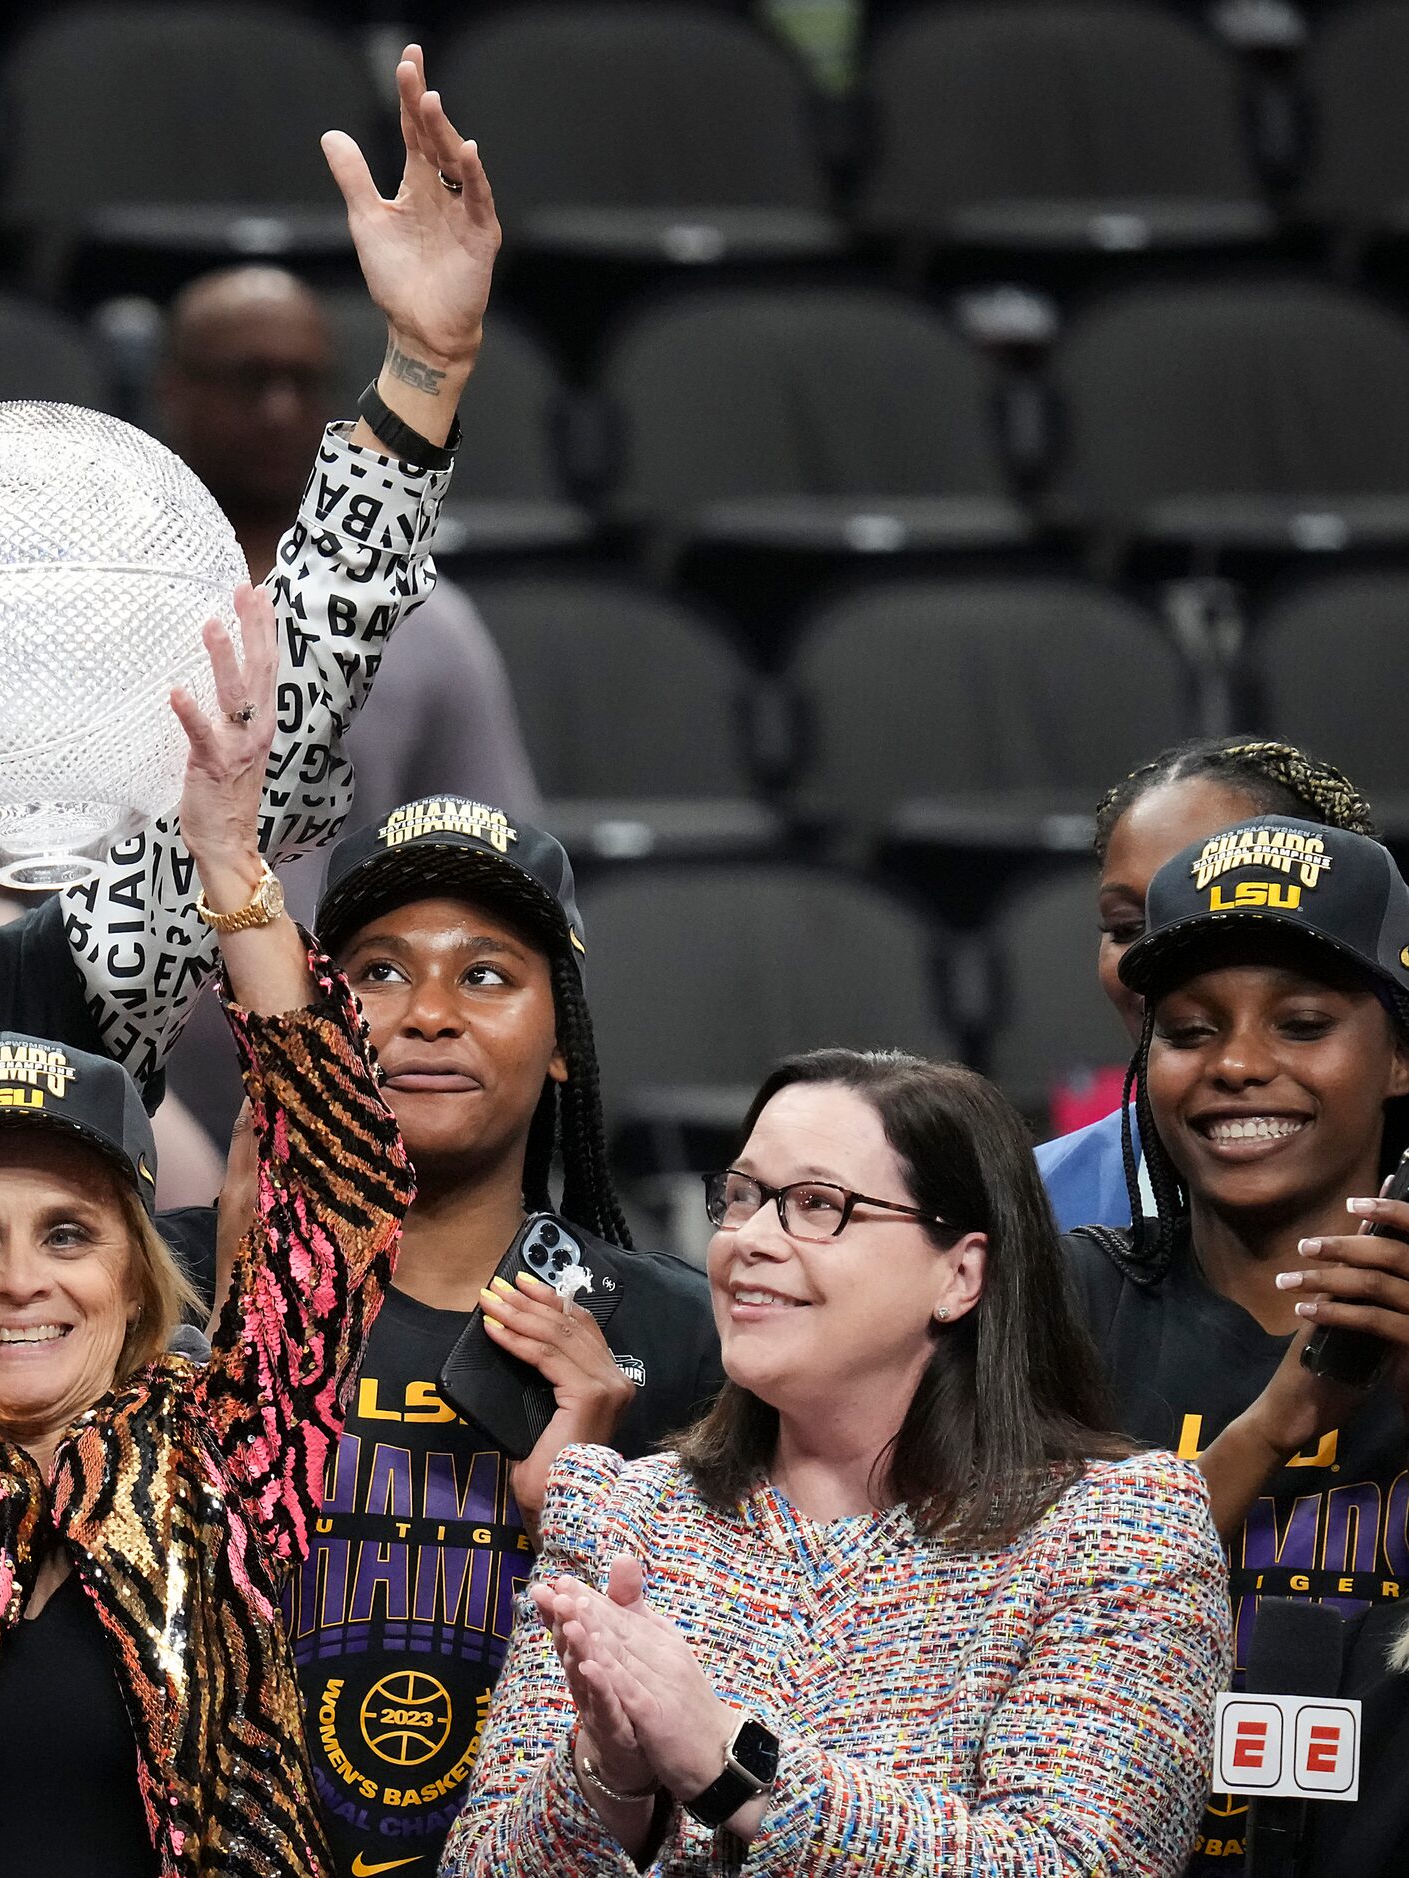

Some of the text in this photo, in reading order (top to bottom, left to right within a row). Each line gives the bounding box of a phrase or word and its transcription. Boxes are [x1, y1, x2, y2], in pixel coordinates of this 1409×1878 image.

[378, 815, 440, 837] NATIONAL
[387, 801, 508, 853] CHAMPS
[1193, 845, 1331, 870] NATIONAL CHAMPIONS
[1196, 830, 1325, 890] CHAMPS
[1210, 882, 1302, 912] LSU
[357, 1378, 469, 1426] LS
[379, 1708, 434, 1728] 2023
[318, 1678, 379, 1799] WOMEN'S
